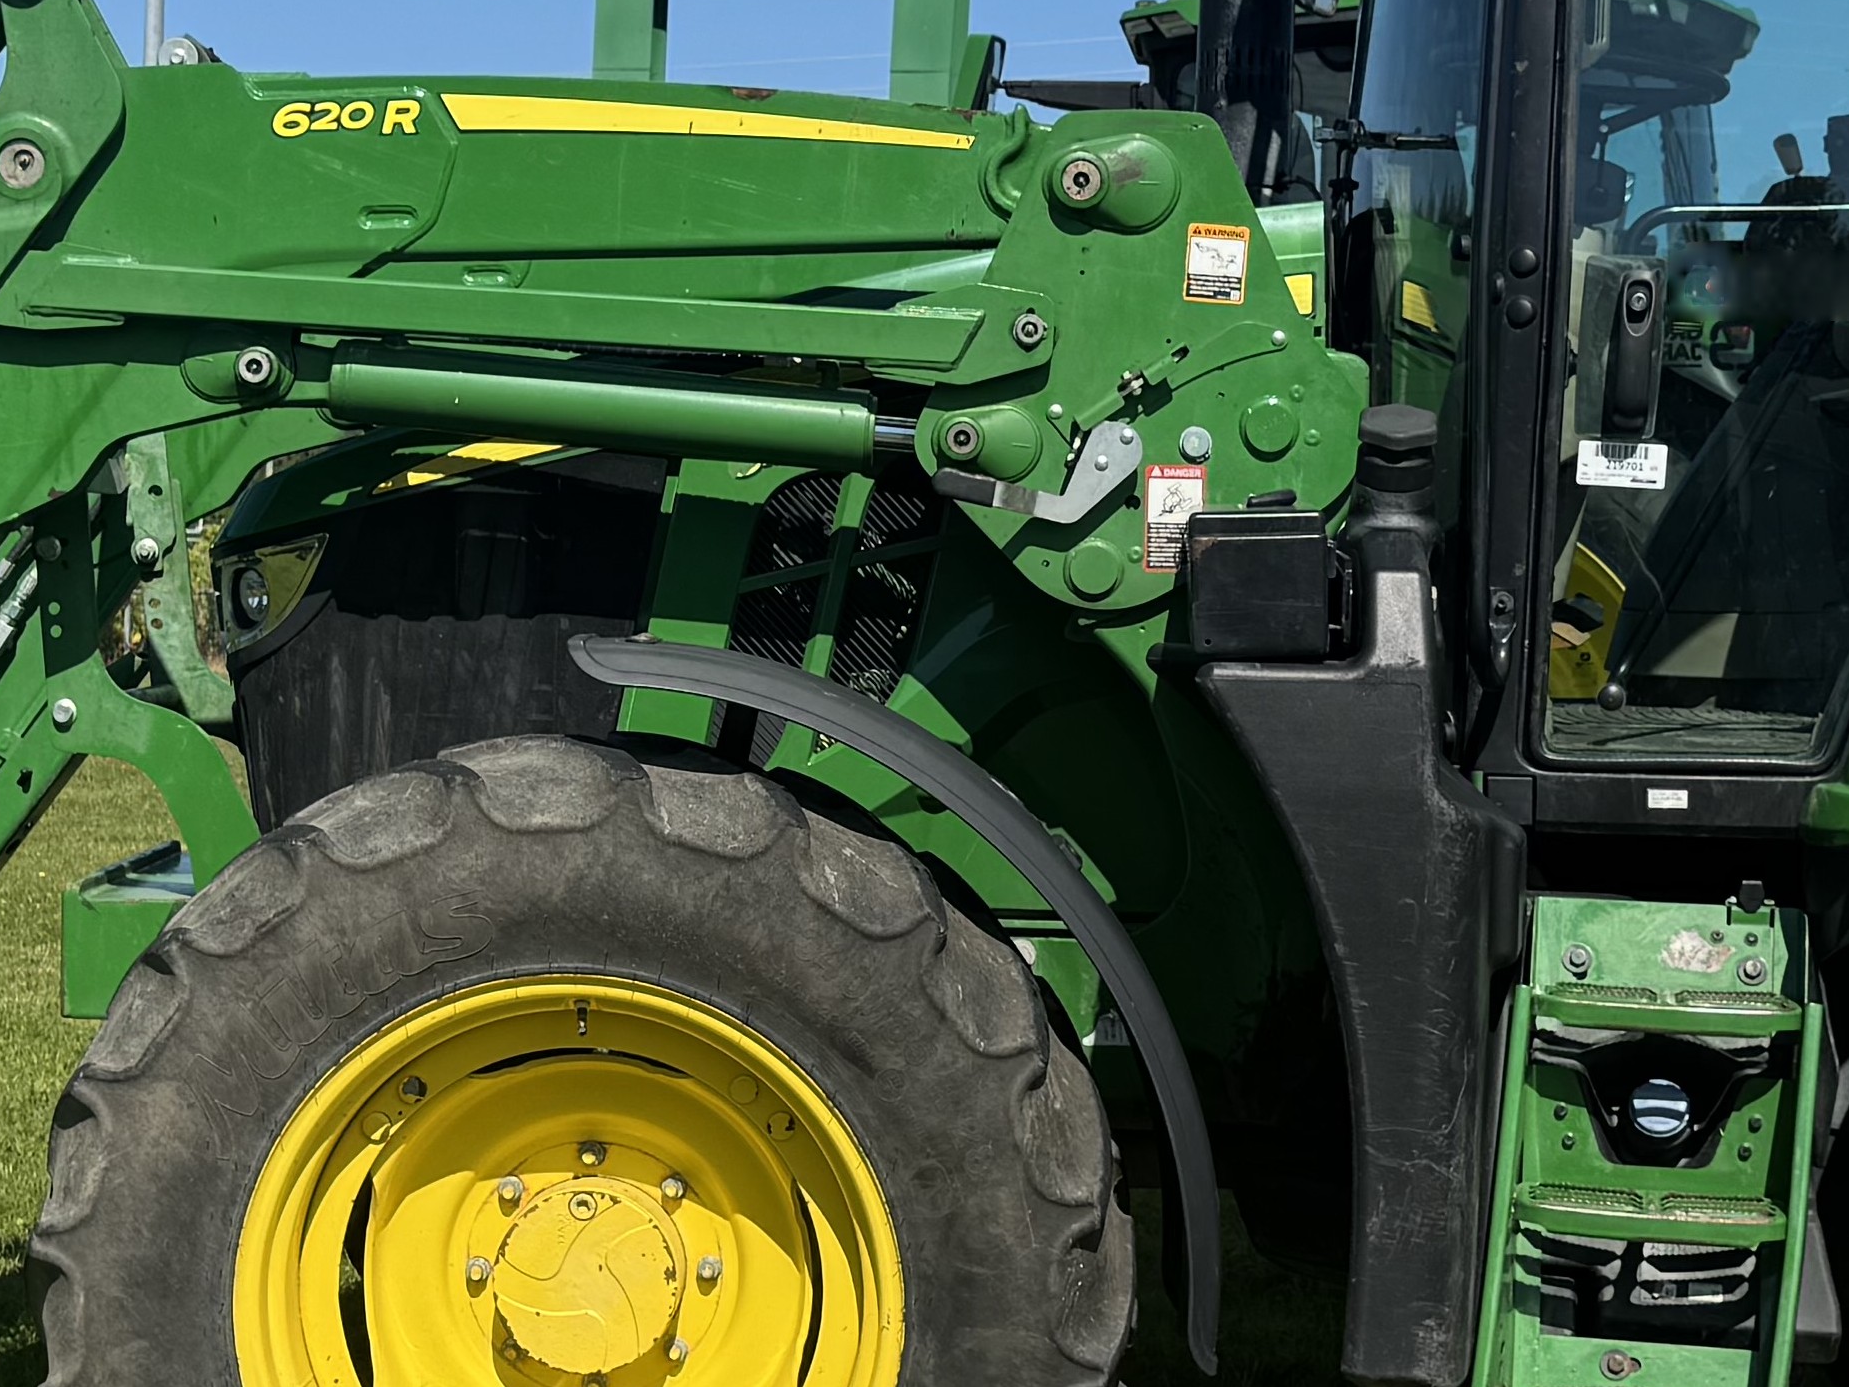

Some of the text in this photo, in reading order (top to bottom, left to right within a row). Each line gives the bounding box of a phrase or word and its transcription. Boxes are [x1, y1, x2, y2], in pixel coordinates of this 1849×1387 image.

[1203, 227, 1245, 239] WARNING
[1163, 467, 1202, 478] DANGER
[184, 888, 496, 1172] Mitas
